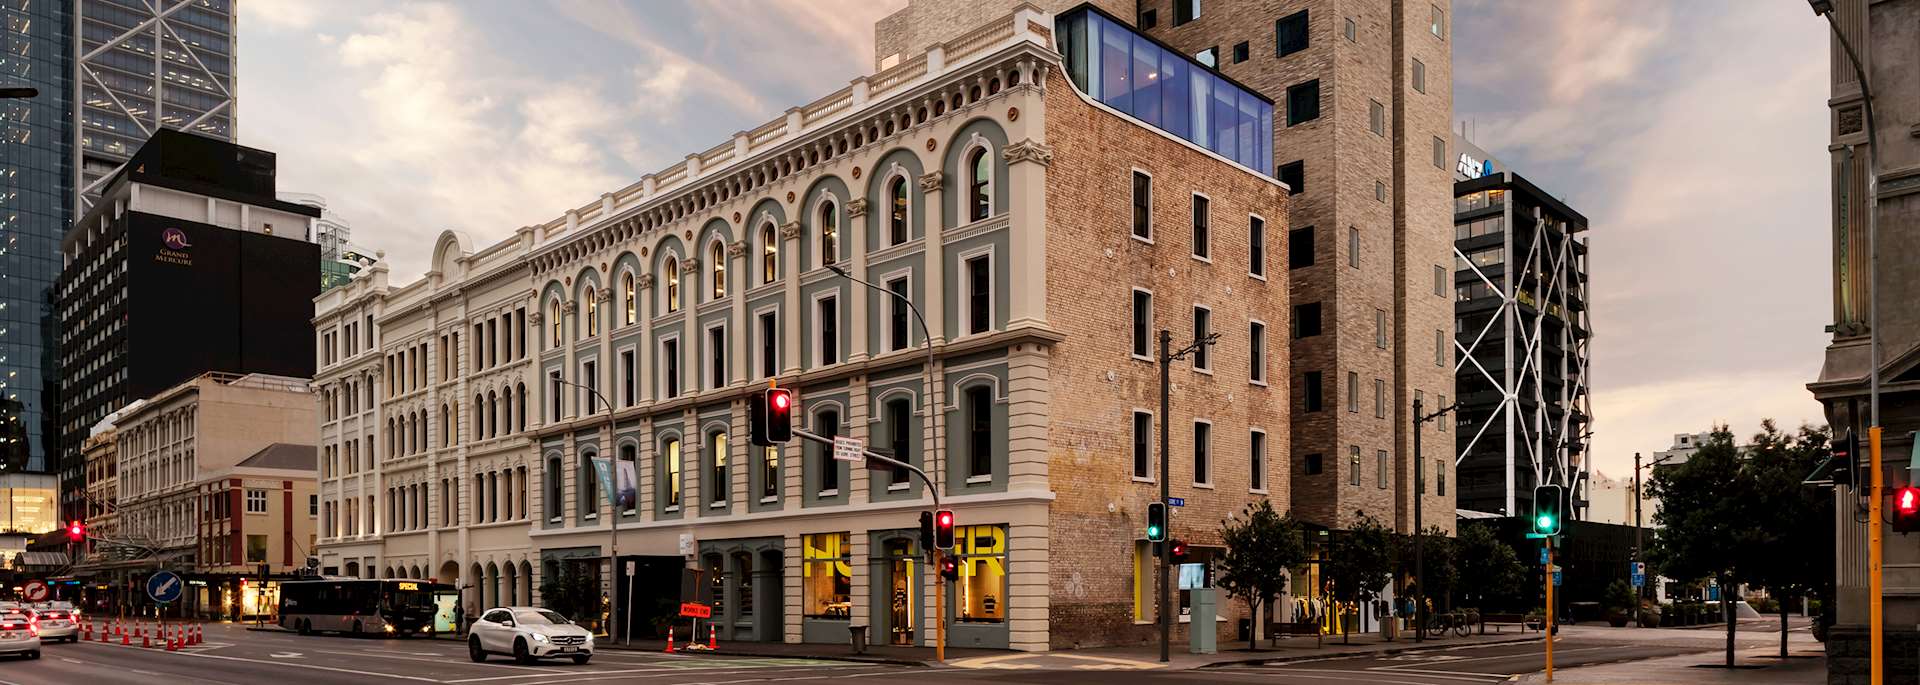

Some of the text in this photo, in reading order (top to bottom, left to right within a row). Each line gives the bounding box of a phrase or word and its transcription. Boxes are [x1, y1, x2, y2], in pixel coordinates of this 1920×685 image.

[1457, 153, 1483, 179] ANZ
[160, 249, 189, 259] GRAND
[154, 255, 192, 266] MERCURE
